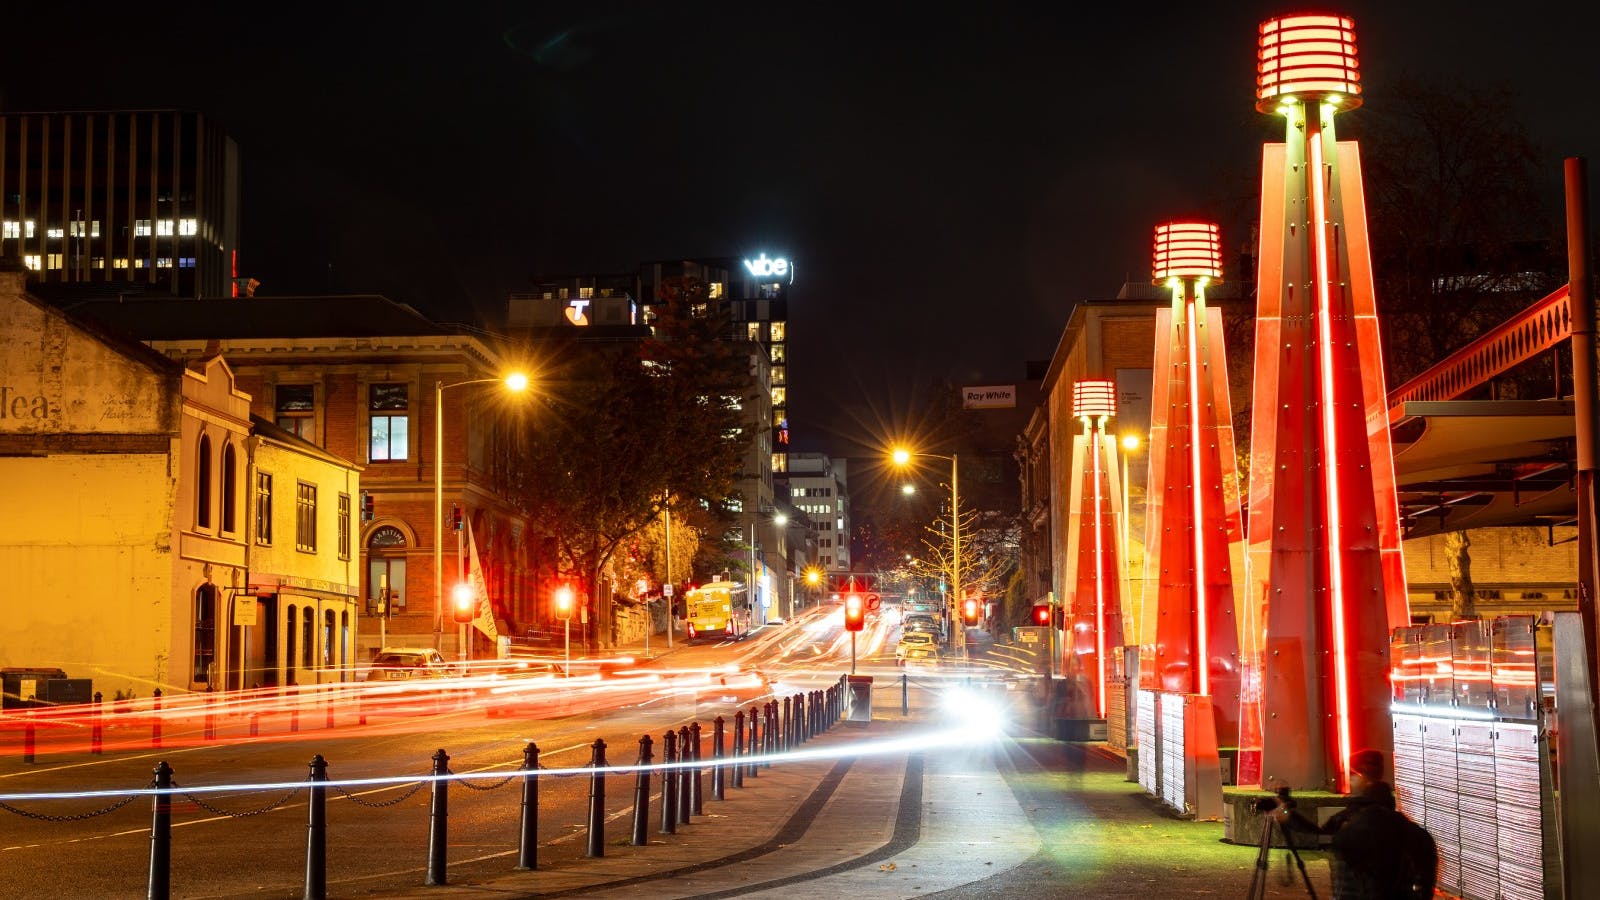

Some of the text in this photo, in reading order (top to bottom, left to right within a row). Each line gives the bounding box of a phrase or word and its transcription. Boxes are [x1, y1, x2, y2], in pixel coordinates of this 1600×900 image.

[744, 253, 788, 276] vibe
[0, 386, 49, 420] Tea
[968, 391, 1011, 401] Ray White
